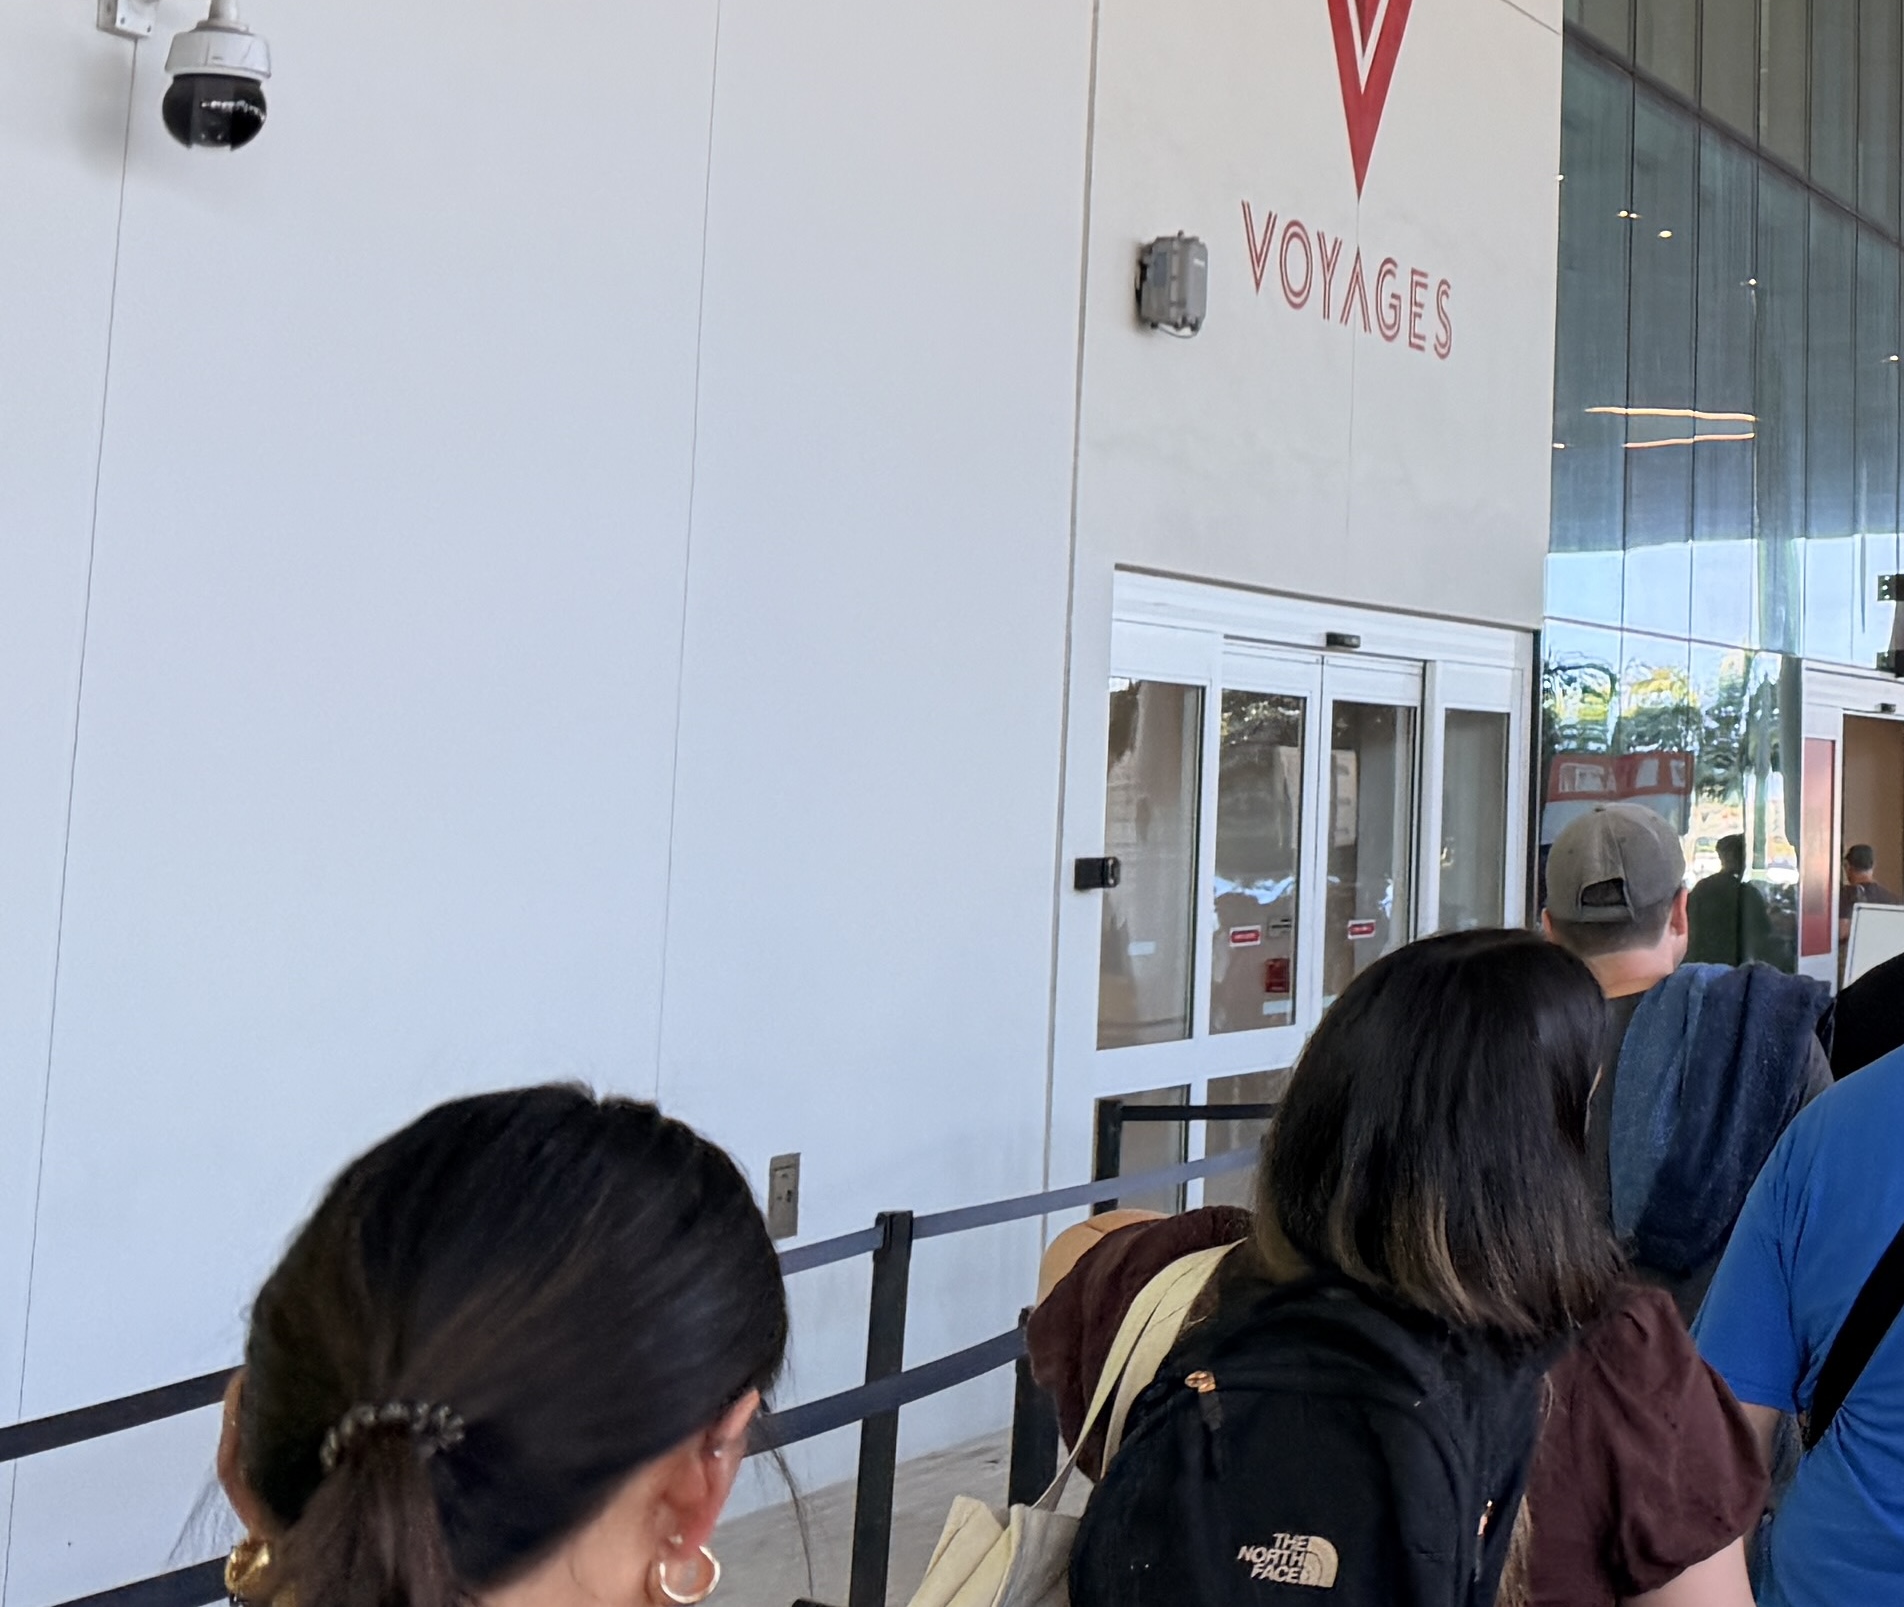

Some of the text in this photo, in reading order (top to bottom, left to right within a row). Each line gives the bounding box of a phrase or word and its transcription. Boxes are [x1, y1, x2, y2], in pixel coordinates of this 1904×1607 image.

[1241, 199, 1453, 360] VOYAGES
[1272, 1532, 1310, 1551] THE
[1236, 1545, 1306, 1567] NORTH
[1250, 1563, 1300, 1585] FACE
